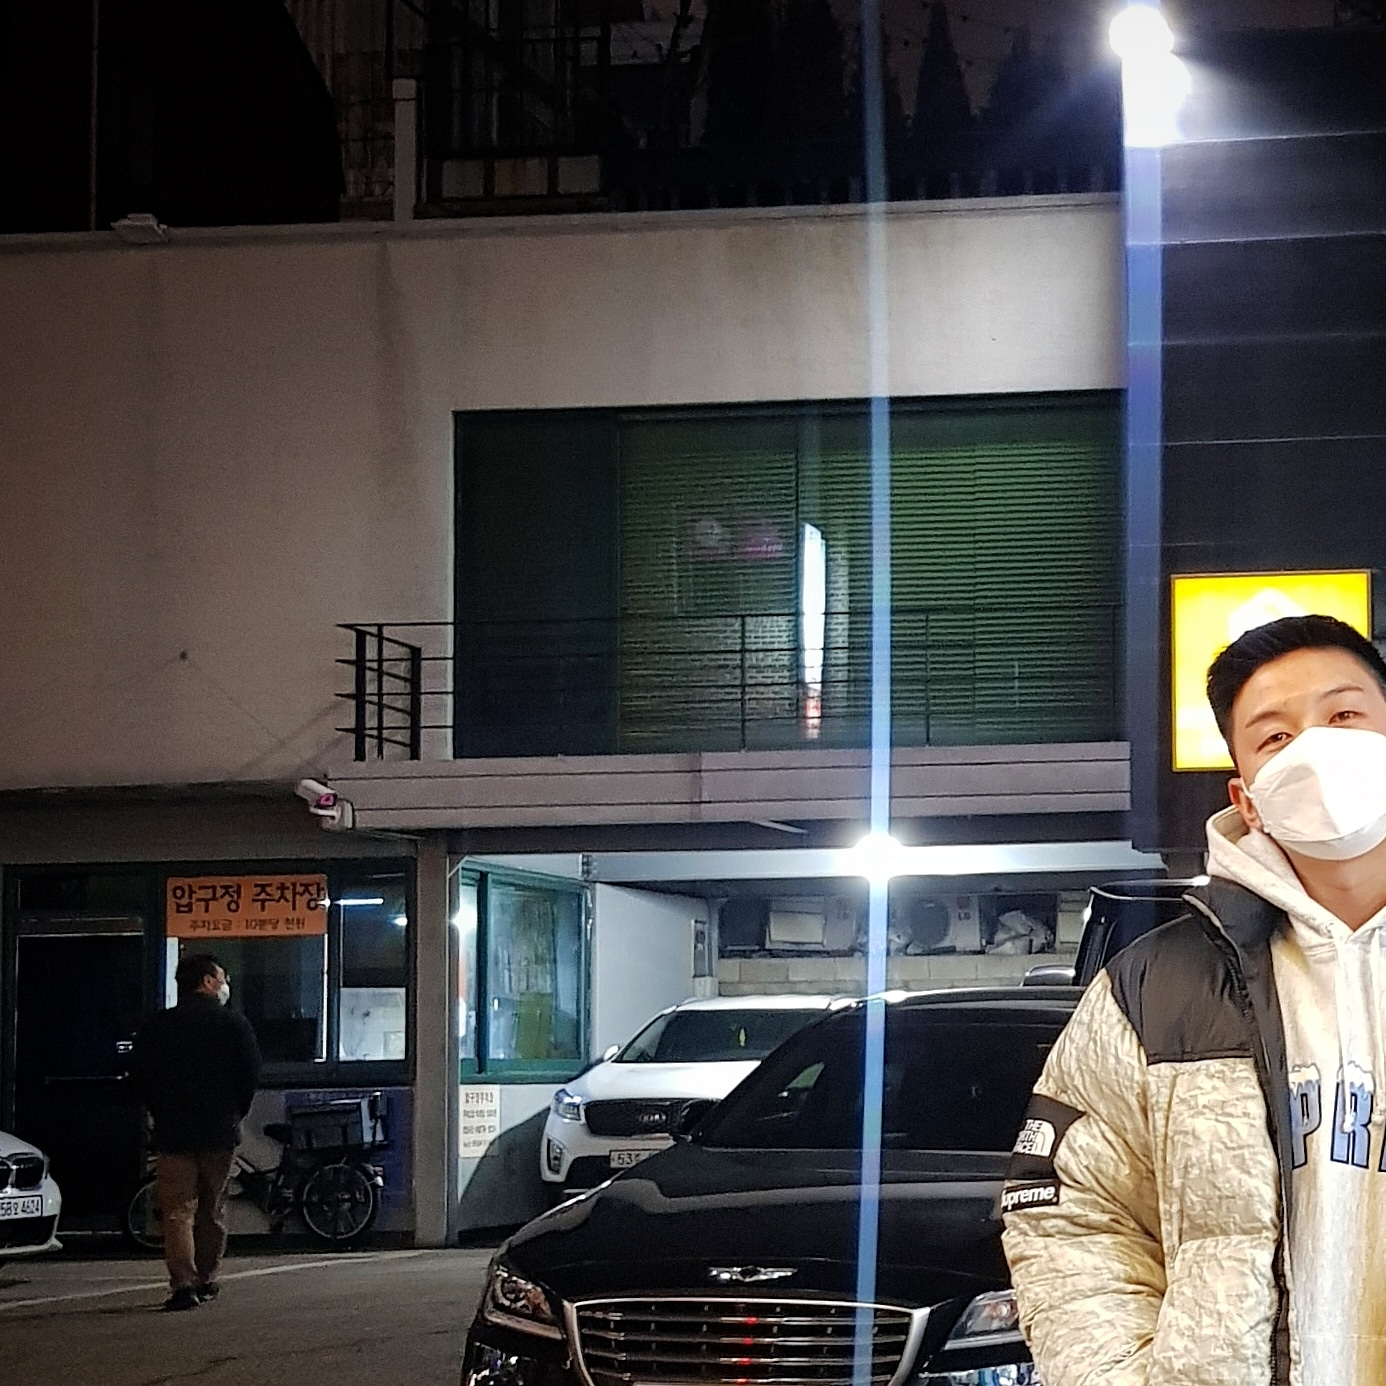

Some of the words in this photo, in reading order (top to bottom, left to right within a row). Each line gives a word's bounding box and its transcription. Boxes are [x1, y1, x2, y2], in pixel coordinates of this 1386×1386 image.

[172, 883, 242, 914] 압구정
[252, 881, 325, 912] 주차장
[618, 1153, 641, 1165] 53
[1001, 1186, 1056, 1210] upreme
